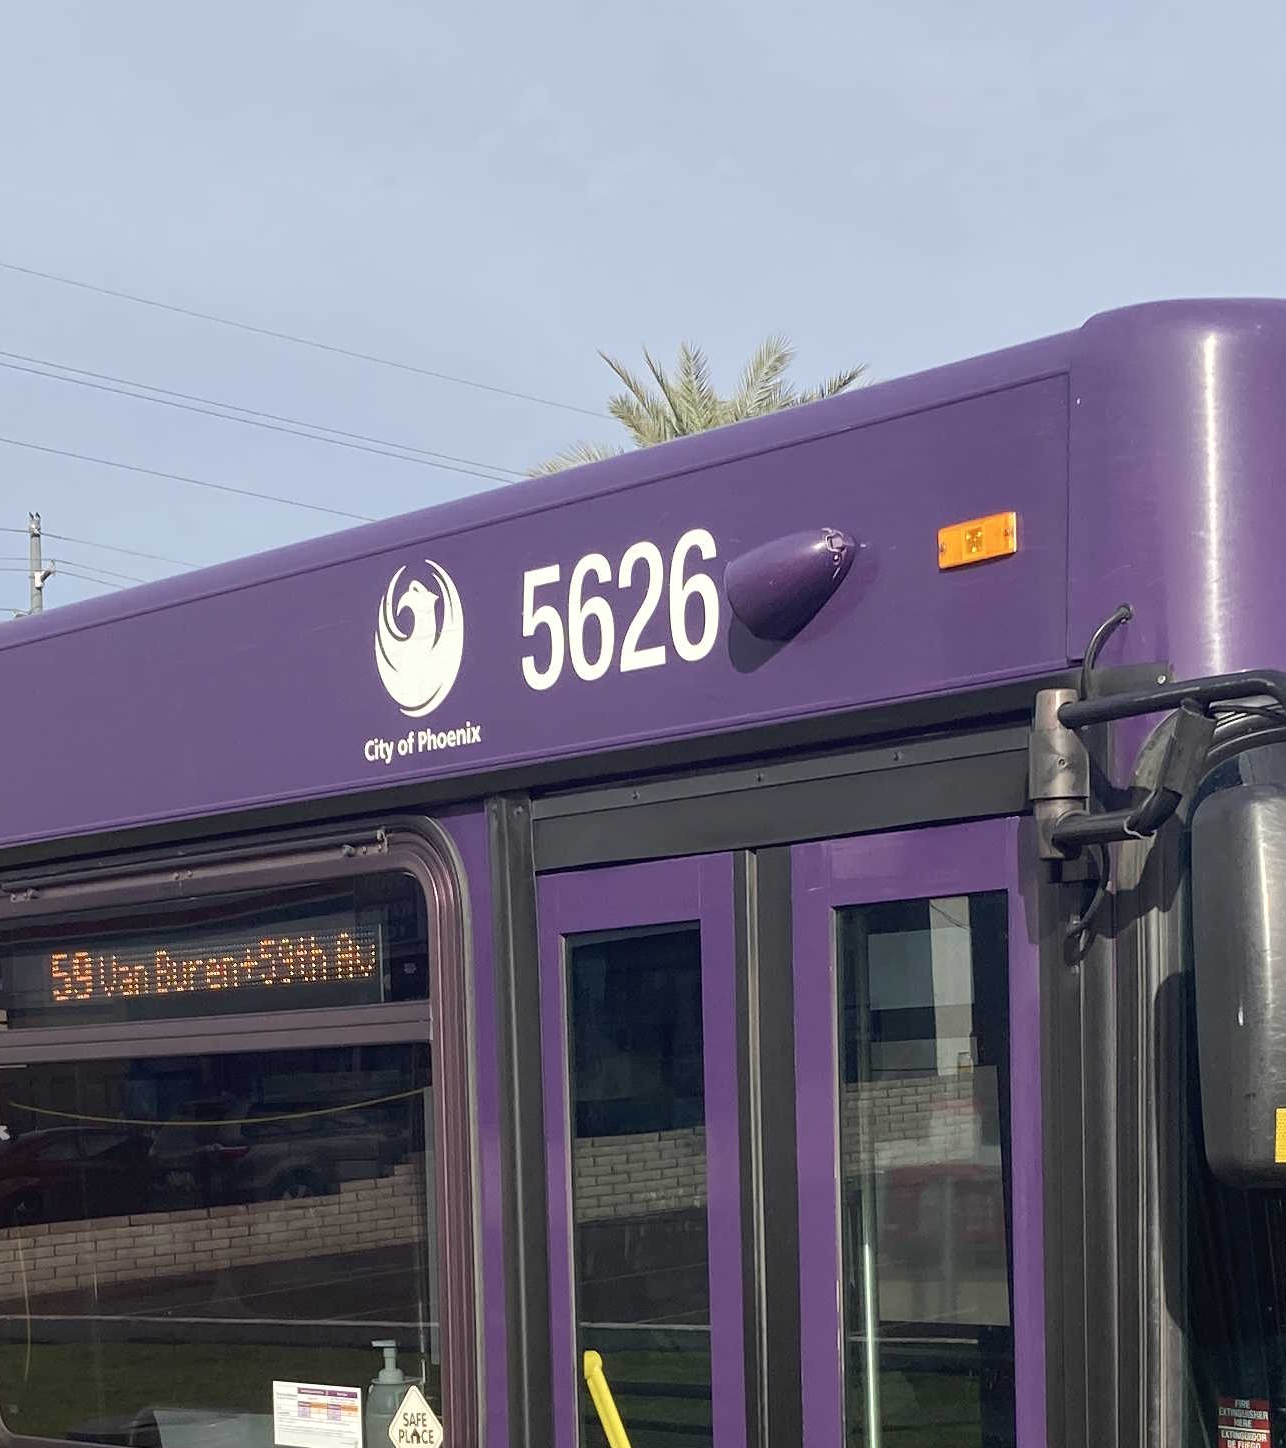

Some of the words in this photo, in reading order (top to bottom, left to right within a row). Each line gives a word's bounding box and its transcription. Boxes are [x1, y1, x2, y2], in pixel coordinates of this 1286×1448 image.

[521, 528, 719, 691] 5626
[364, 738, 394, 765] City
[397, 730, 415, 756] of
[417, 720, 482, 753] Phoenix
[51, 950, 93, 1001] 59
[99, 954, 150, 998] Van
[398, 1428, 435, 1445] PLACE
[402, 1412, 428, 1428] SAFE
